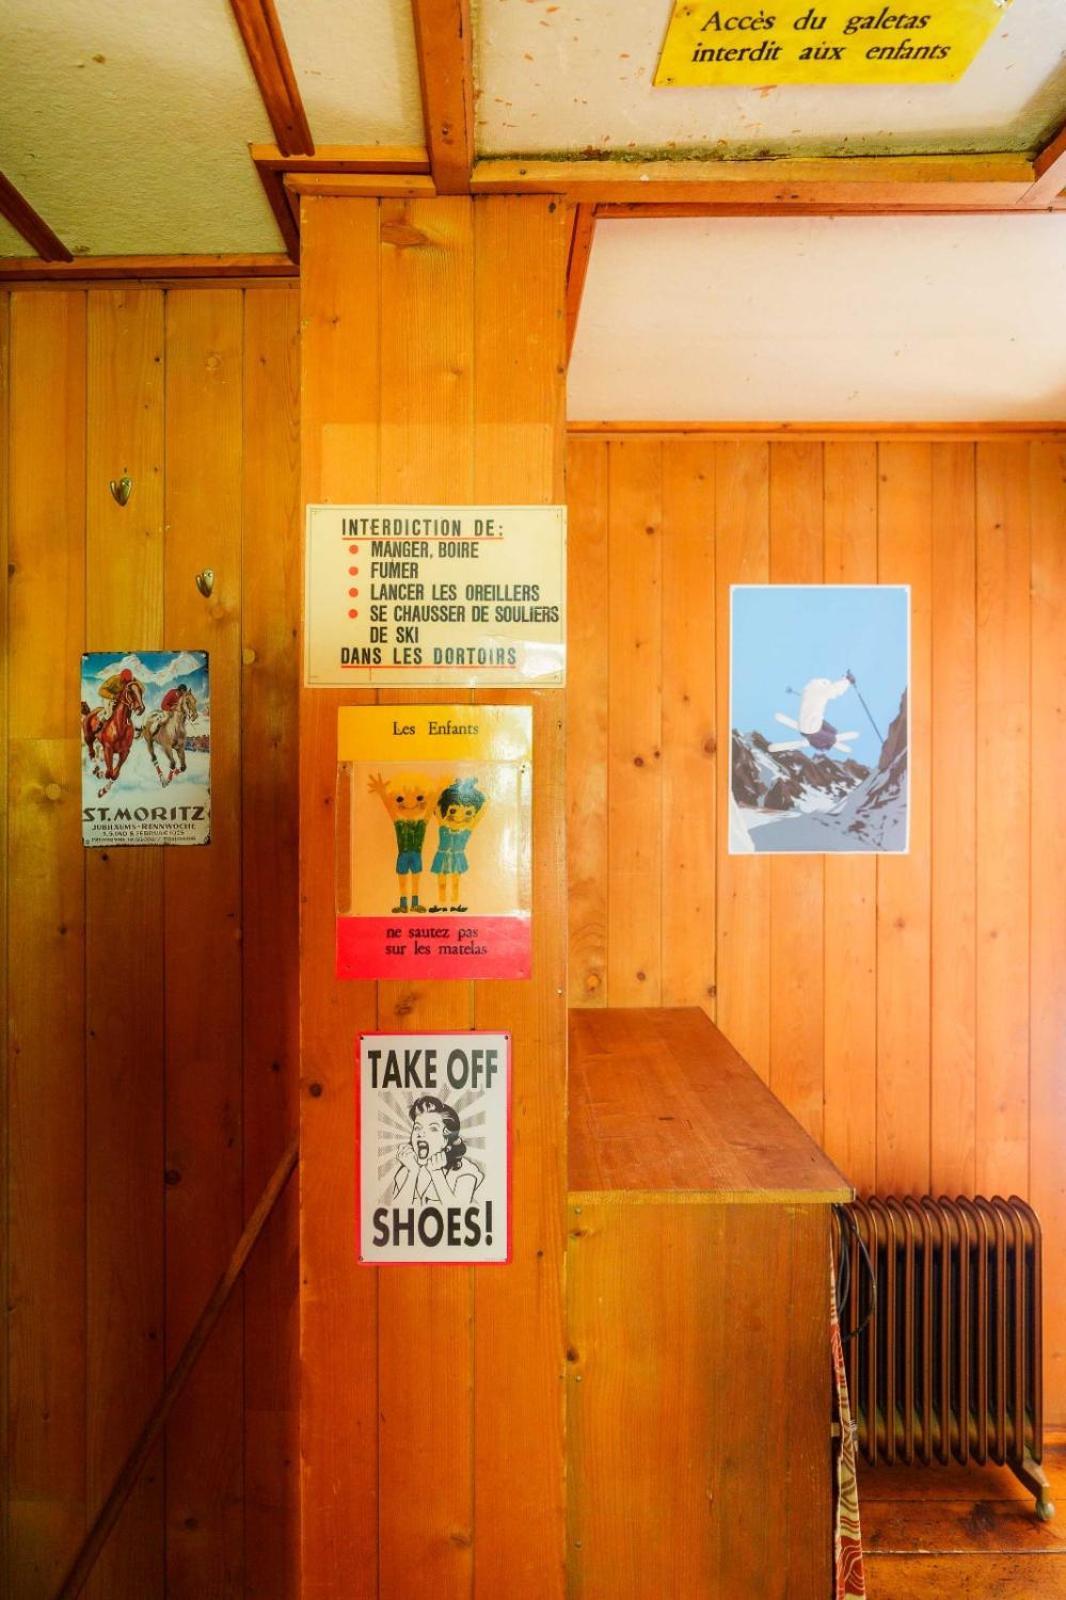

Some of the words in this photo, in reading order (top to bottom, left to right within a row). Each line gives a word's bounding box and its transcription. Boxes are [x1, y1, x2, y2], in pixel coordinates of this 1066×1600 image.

[700, 10, 776, 33] Accès
[793, 8, 827, 31] du
[843, 7, 931, 35] galetas
[691, 40, 783, 63] interdit
[799, 44, 846, 61] aux
[865, 38, 951, 61] enfants
[341, 518, 462, 536] INTERDICTION
[474, 519, 504, 536] DE:
[371, 541, 433, 559] MANGER,
[438, 541, 479, 558] BOIRE
[371, 562, 419, 579] FUMER
[370, 584, 424, 601] LANCER
[432, 584, 457, 601] LES
[465, 584, 540, 602] OREILLERS
[370, 605, 387, 622] SE
[393, 605, 465, 622] CHAUSSER
[472, 605, 489, 622] DE
[495, 605, 559, 623] SOULIERS
[370, 626, 388, 643] DE
[396, 626, 419, 643] SKI
[341, 647, 382, 664] DANS
[393, 647, 422, 664] LES
[433, 647, 517, 665] DORTOIRS
[392, 721, 416, 736] Les
[428, 720, 480, 736] Enfants
[386, 927, 402, 938] ne
[408, 926, 450, 939] sautez
[457, 926, 479, 942] pas
[385, 944, 407, 956] sur
[413, 942, 431, 956] les
[438, 942, 488, 956] matelas
[367, 1049, 437, 1089] TAKE
[446, 1048, 498, 1090] OFF
[372, 1200, 493, 1248] SHOES!
